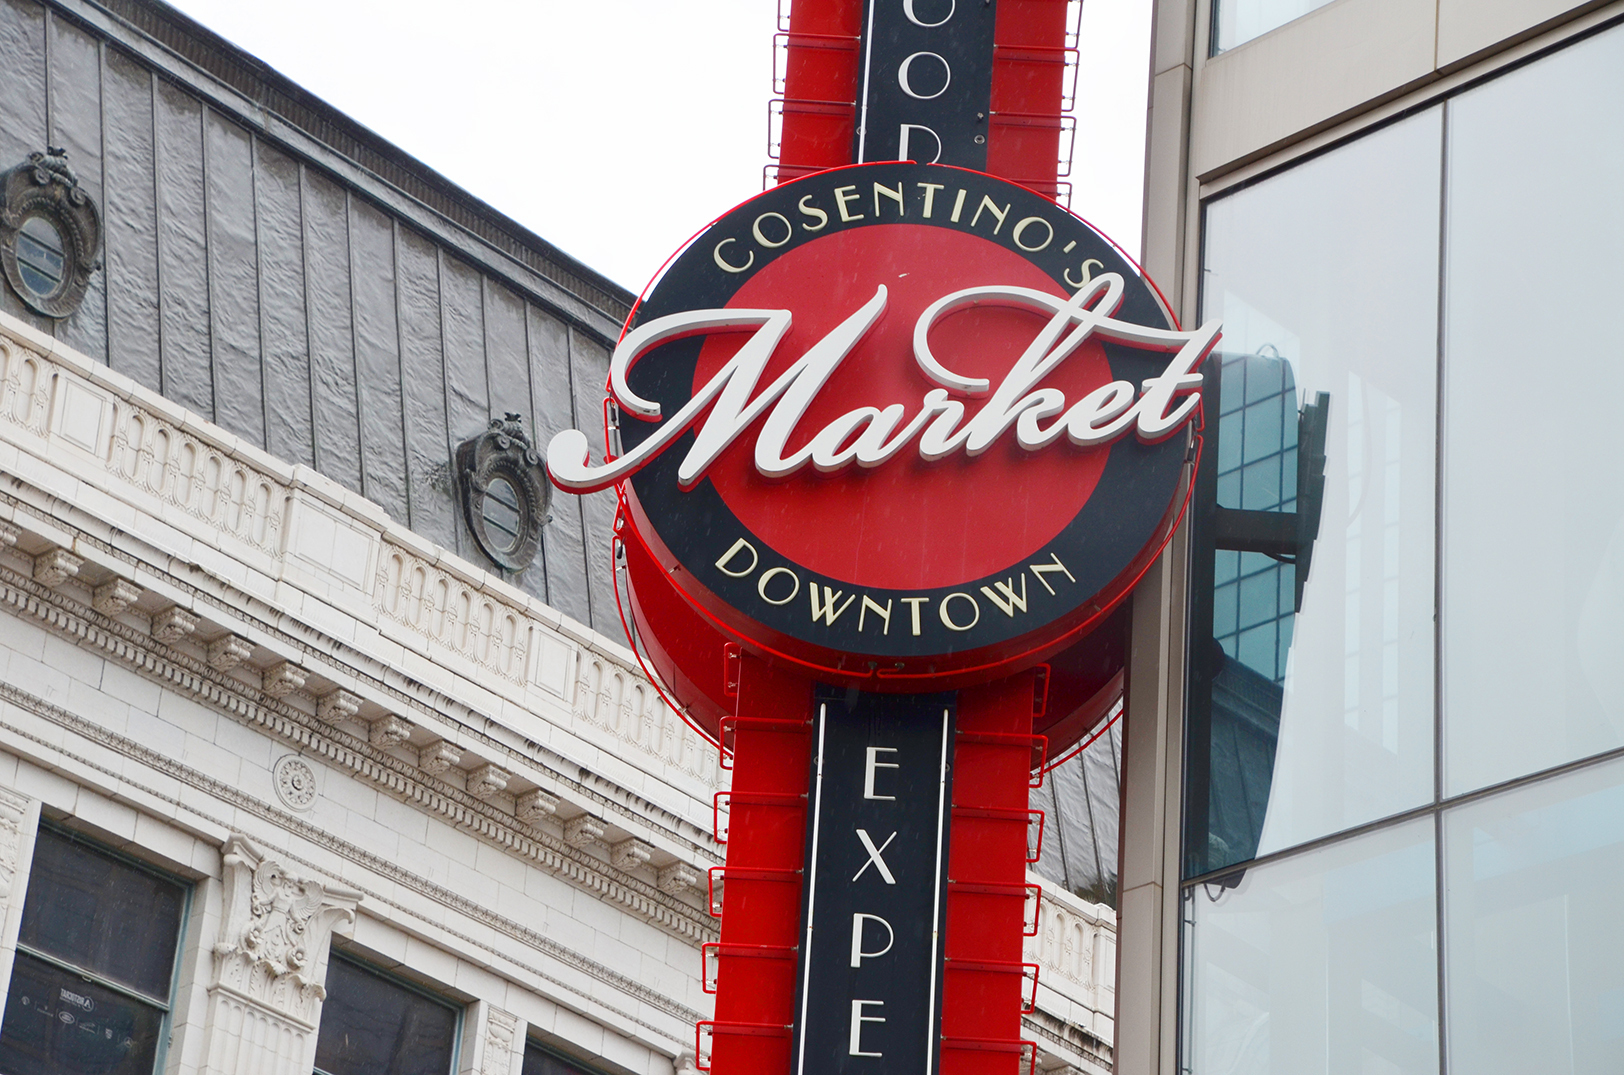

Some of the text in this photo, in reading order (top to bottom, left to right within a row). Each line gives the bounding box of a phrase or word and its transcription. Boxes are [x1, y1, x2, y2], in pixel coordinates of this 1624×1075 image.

[714, 181, 1104, 289] COSENTINO'S
[547, 272, 1223, 494] Market
[715, 537, 1076, 636] DOWNTOWN
[849, 746, 900, 1057] EXPE
